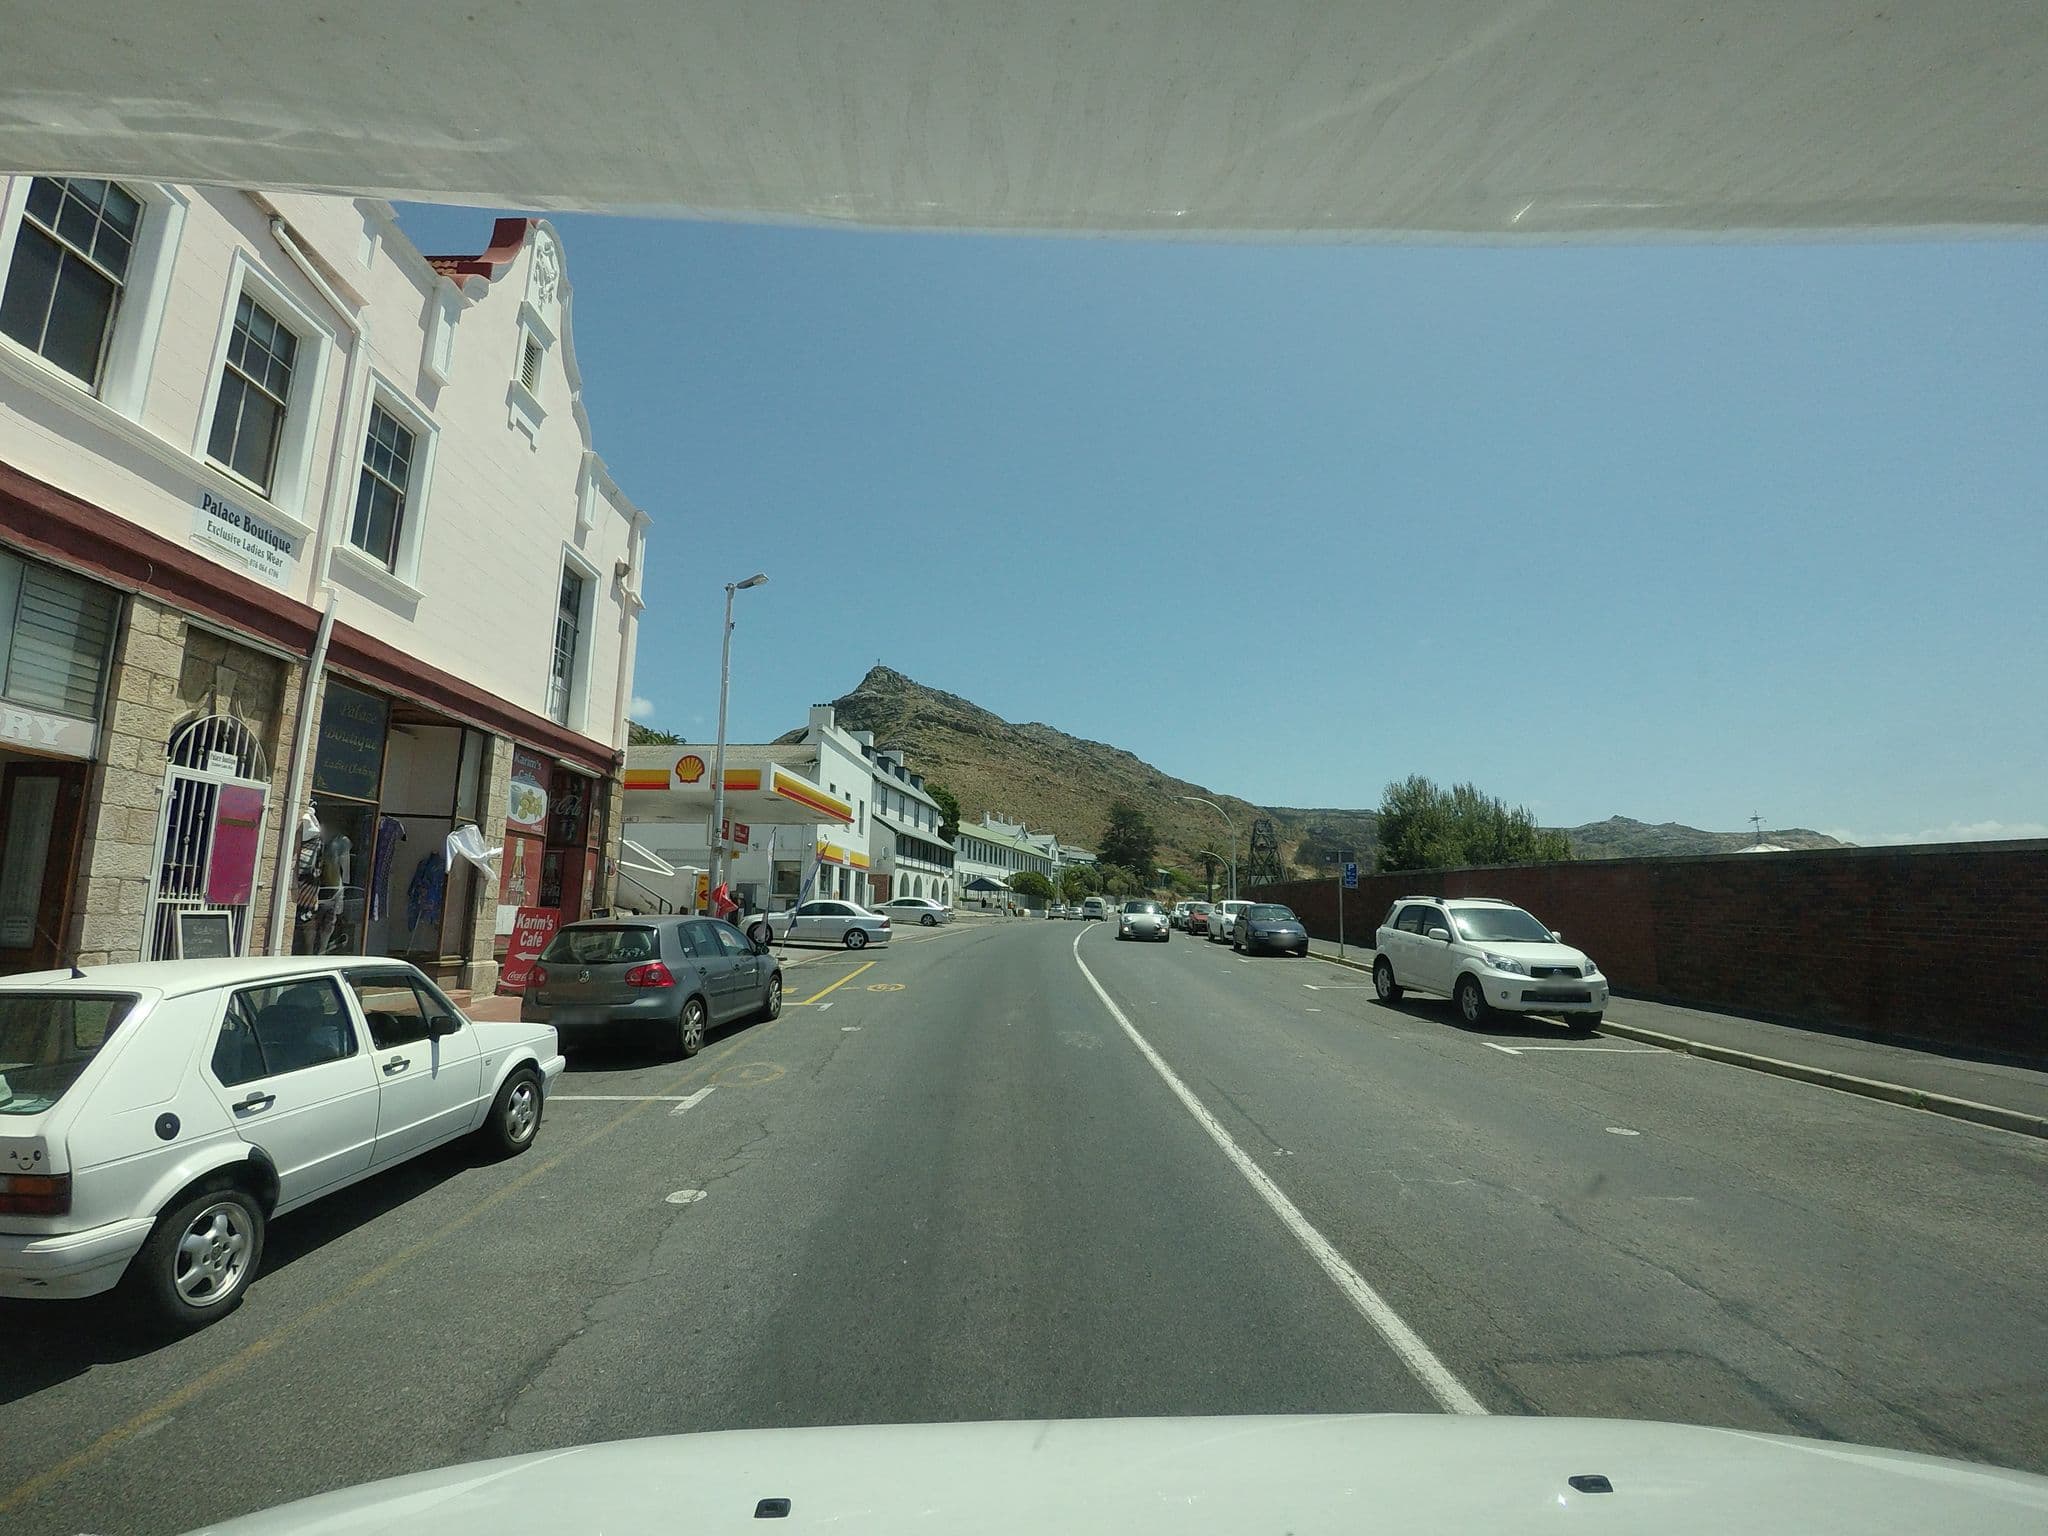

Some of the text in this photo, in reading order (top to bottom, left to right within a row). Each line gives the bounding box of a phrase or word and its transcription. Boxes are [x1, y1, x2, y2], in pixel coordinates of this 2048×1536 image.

[202, 492, 291, 554] Palace Boutique
[207, 520, 283, 567] Exclusive Ladies Wear
[516, 913, 554, 931] Karim's
[520, 931, 543, 947] Café
